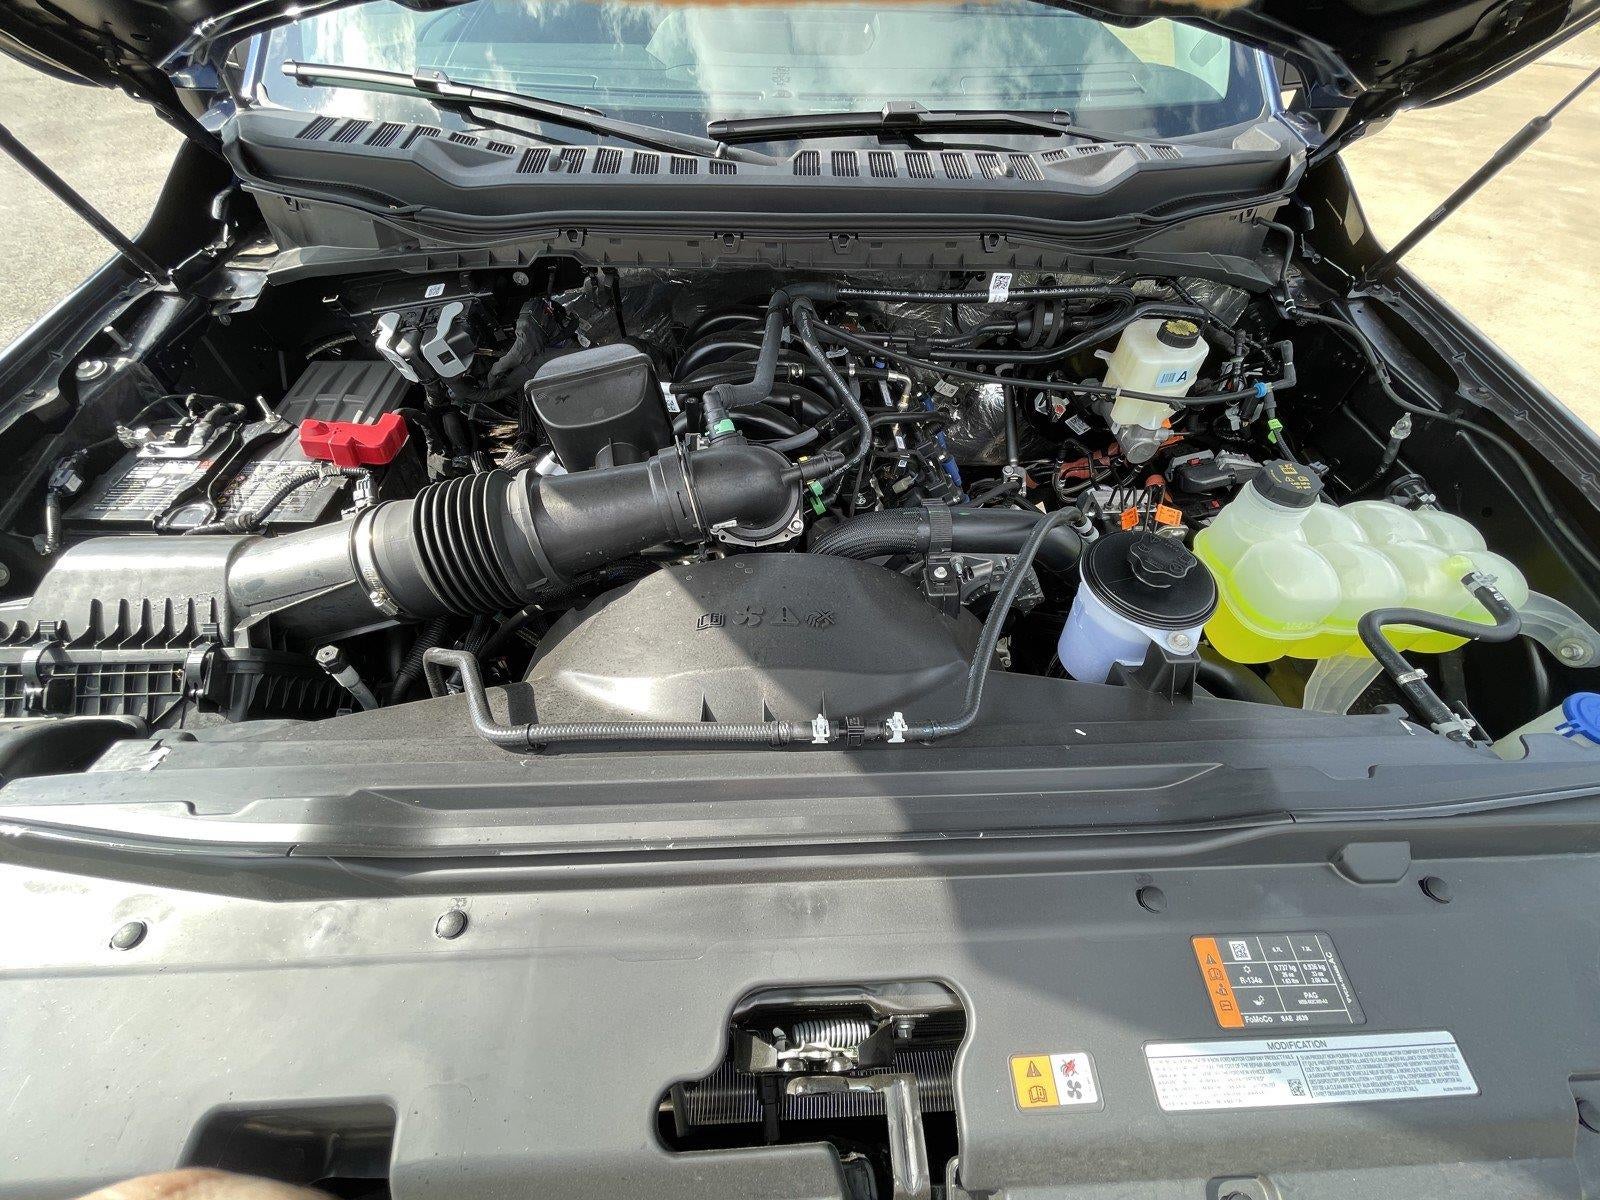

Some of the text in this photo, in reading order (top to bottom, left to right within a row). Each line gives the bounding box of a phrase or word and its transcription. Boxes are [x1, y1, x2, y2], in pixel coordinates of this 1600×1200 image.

[1176, 371, 1188, 382] A
[1239, 976, 1263, 984] R-134a
[1267, 1040, 1327, 1050] MODIFICATION
